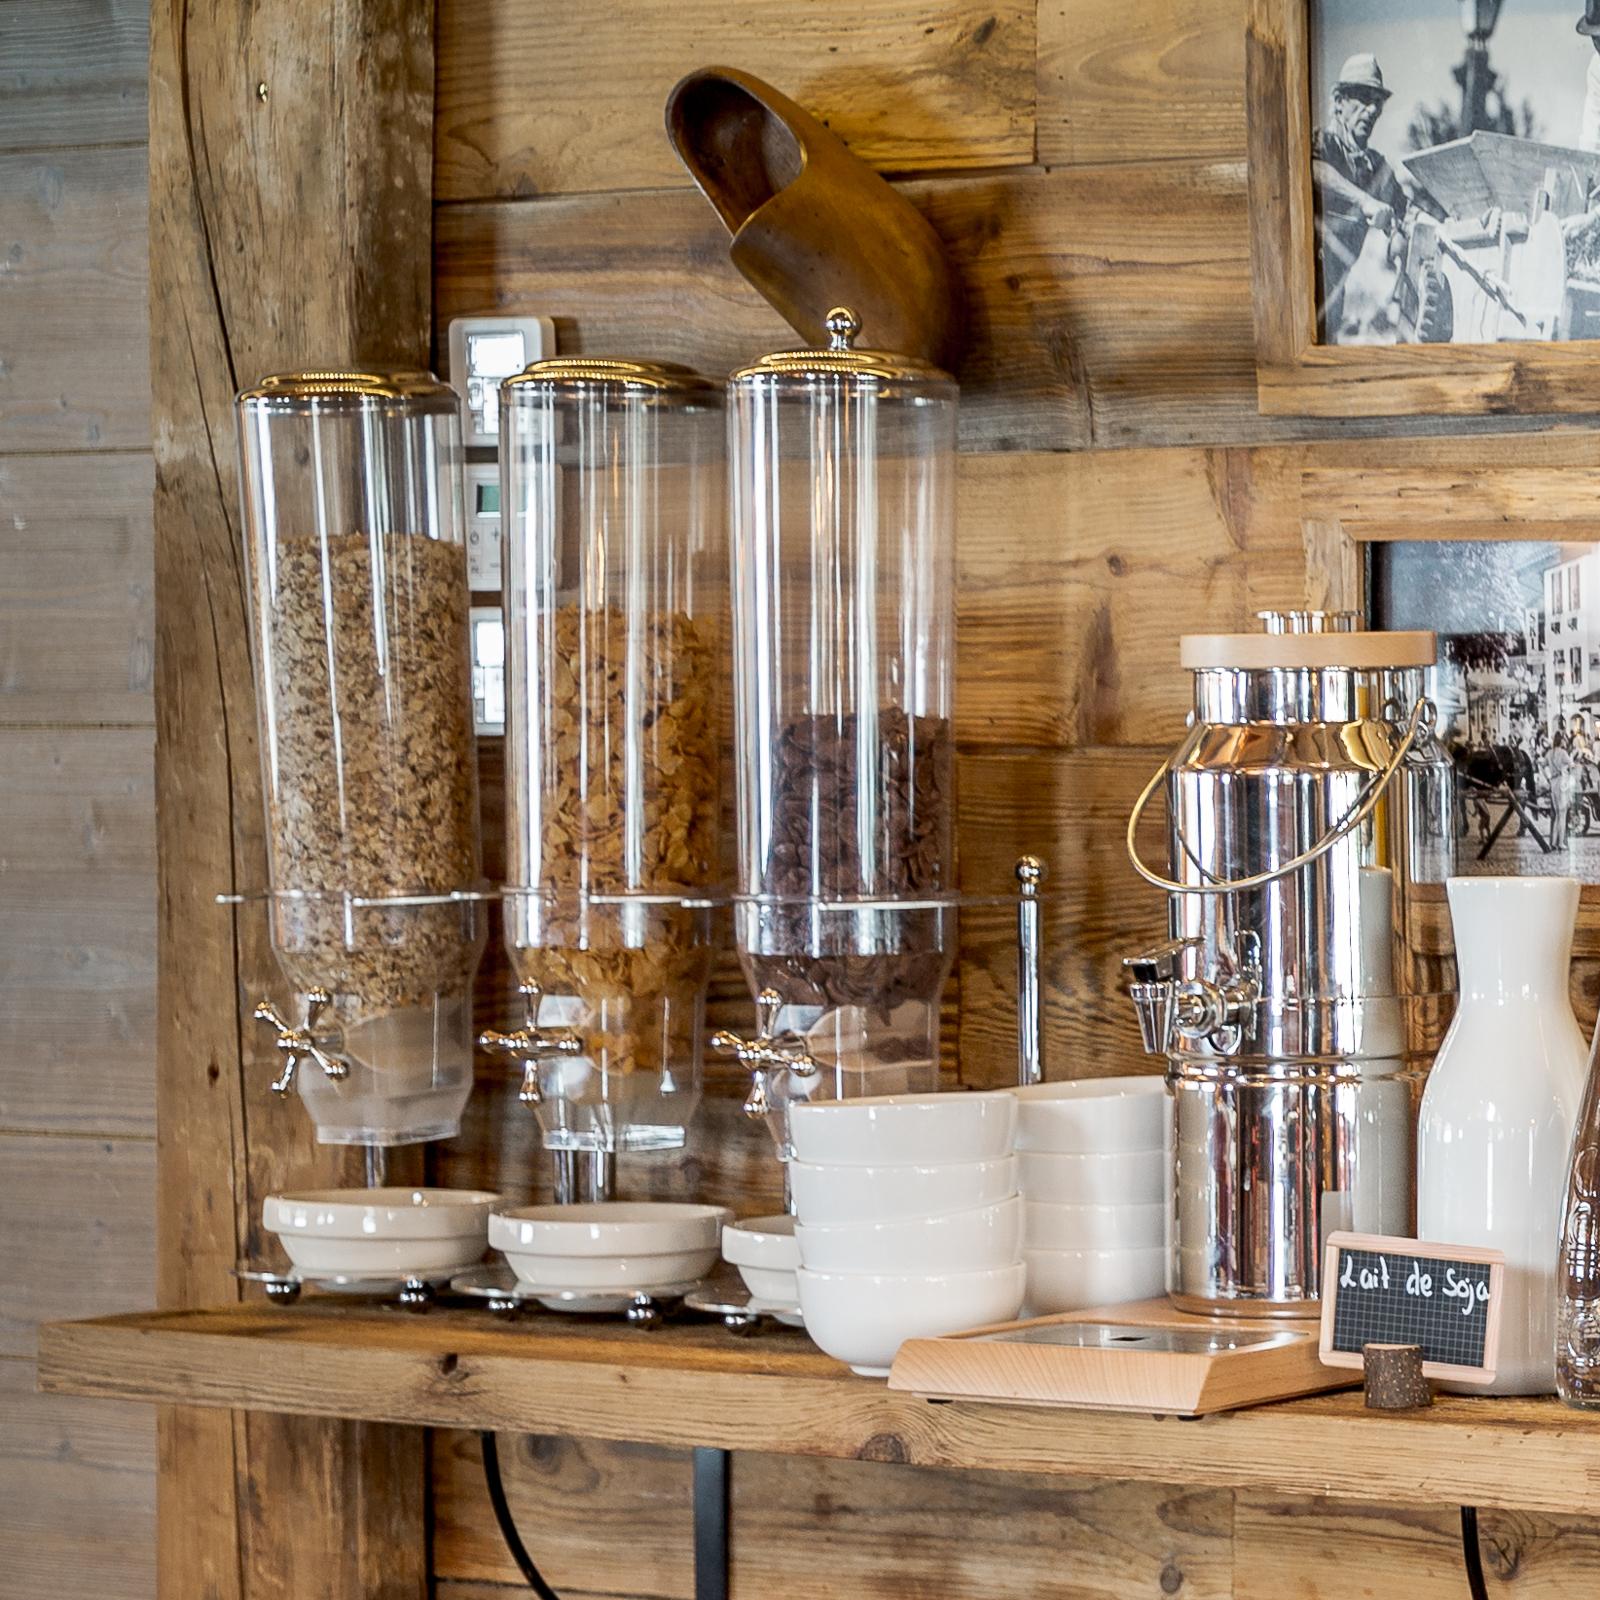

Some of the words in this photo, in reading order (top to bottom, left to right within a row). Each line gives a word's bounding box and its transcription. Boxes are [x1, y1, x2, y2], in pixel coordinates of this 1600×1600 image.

[1339, 1254, 1390, 1290] Lait
[1406, 1260, 1433, 1298] de
[1442, 1267, 1491, 1316] Soja
